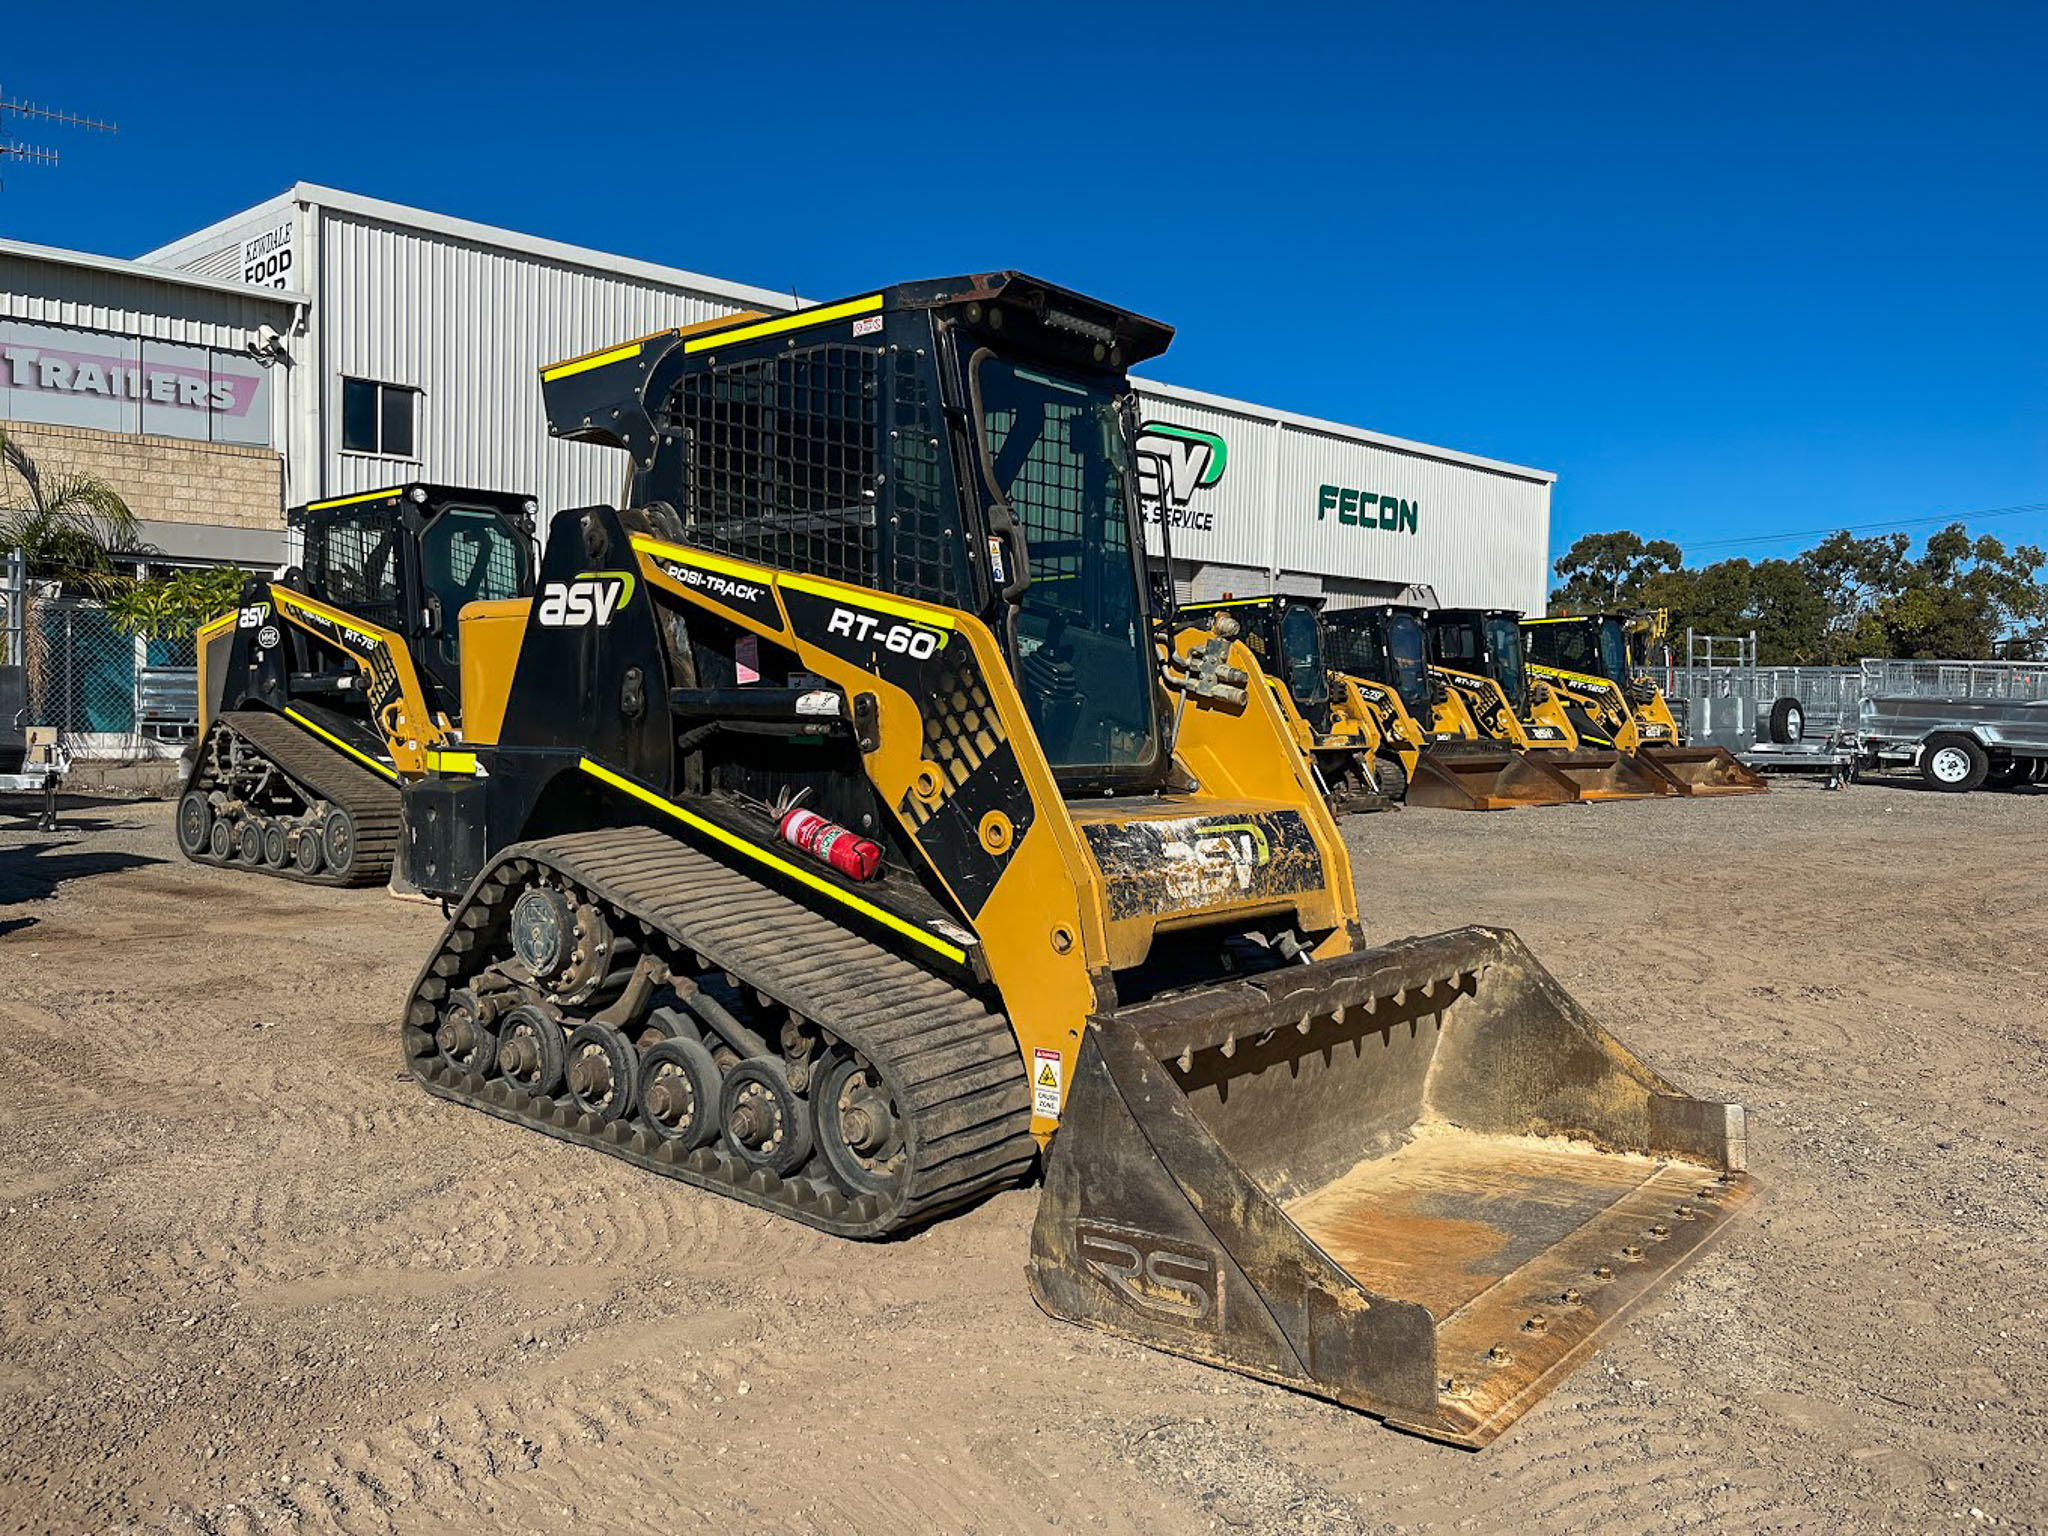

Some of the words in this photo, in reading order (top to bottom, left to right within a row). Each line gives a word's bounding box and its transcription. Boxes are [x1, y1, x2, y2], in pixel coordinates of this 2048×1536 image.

[245, 221, 292, 264] KEWDALE
[245, 249, 292, 283] FOOD
[5, 349, 237, 411] TRAILERS
[1153, 506, 1213, 531] SERVICE
[1318, 484, 1418, 535] FECON
[667, 565, 760, 602] POSI-TRACK
[344, 628, 375, 650] RT-75
[827, 607, 937, 660] RT-60
